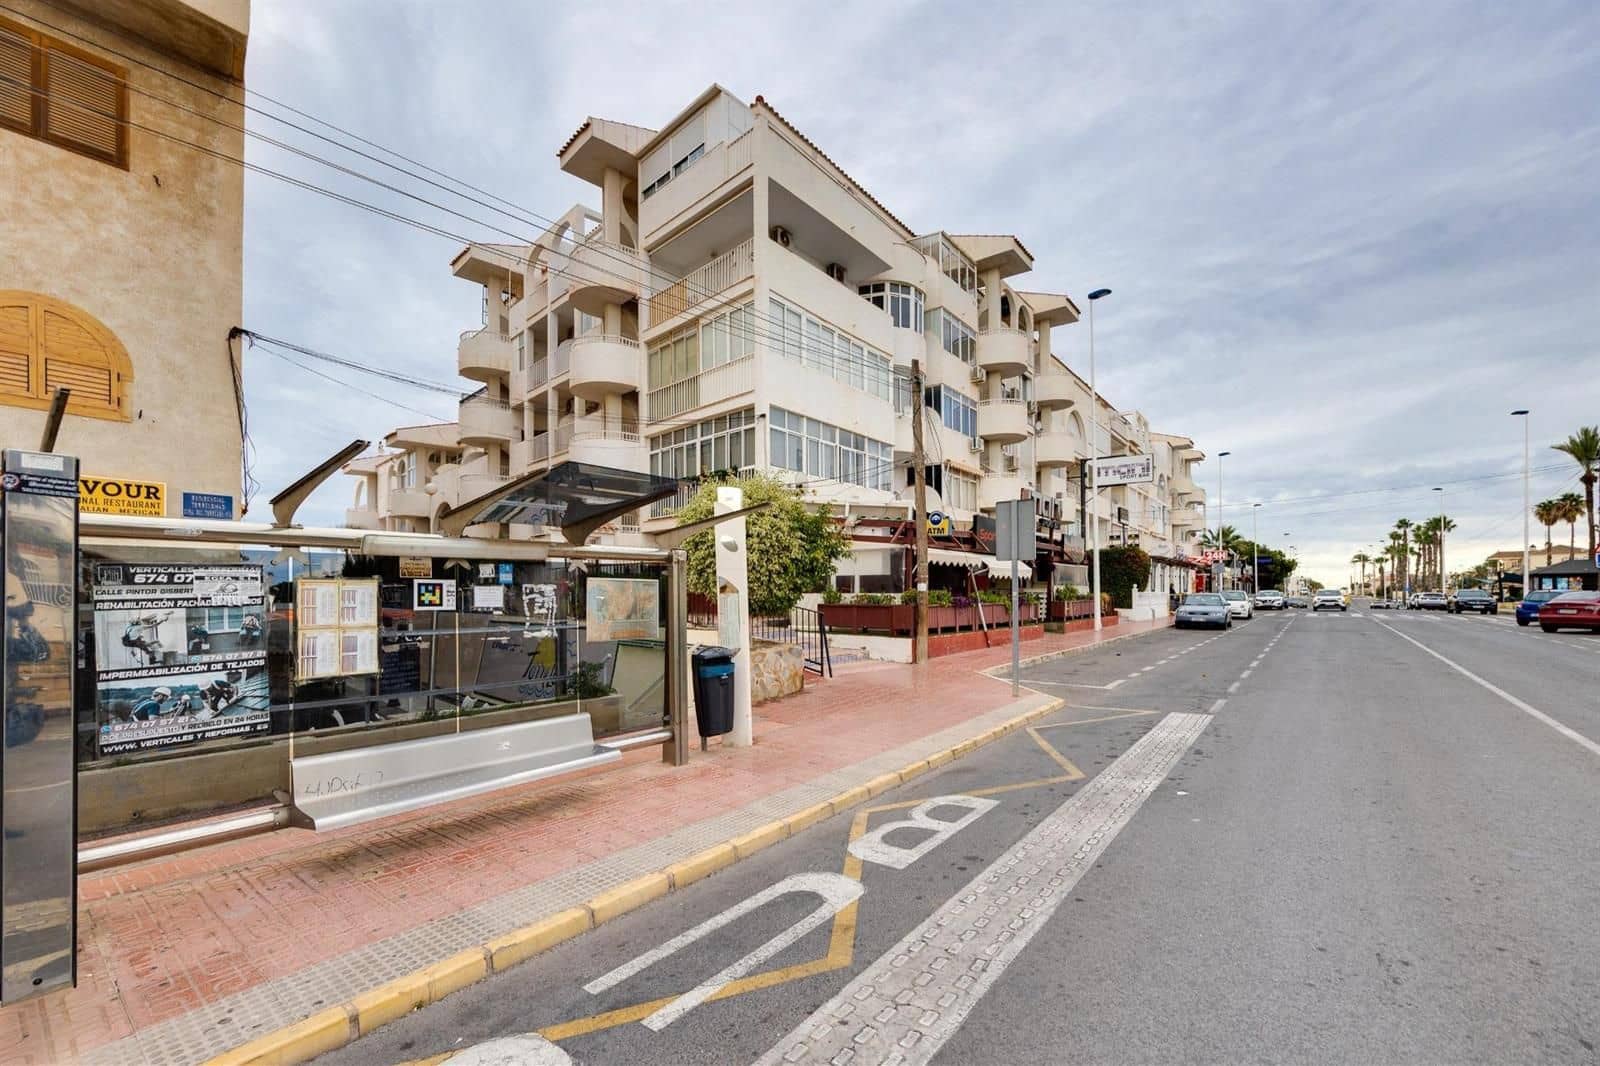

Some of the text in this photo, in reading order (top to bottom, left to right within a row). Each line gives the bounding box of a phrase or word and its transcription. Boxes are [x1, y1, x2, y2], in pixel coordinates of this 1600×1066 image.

[79, 479, 161, 500] VOUR
[103, 498, 161, 509] RESTAURANT
[928, 527, 945, 535] ATM
[134, 574, 168, 583] 674
[173, 573, 193, 583] 07
[95, 599, 175, 610] REHABILITACIÓN
[99, 659, 265, 681] IMPERMEABILIZACIÓN DE TEJADOS
[234, 716, 246, 724] 24
[248, 712, 269, 722] HORAS
[140, 734, 194, 748] VERTICALES
[195, 732, 203, 740] Y
